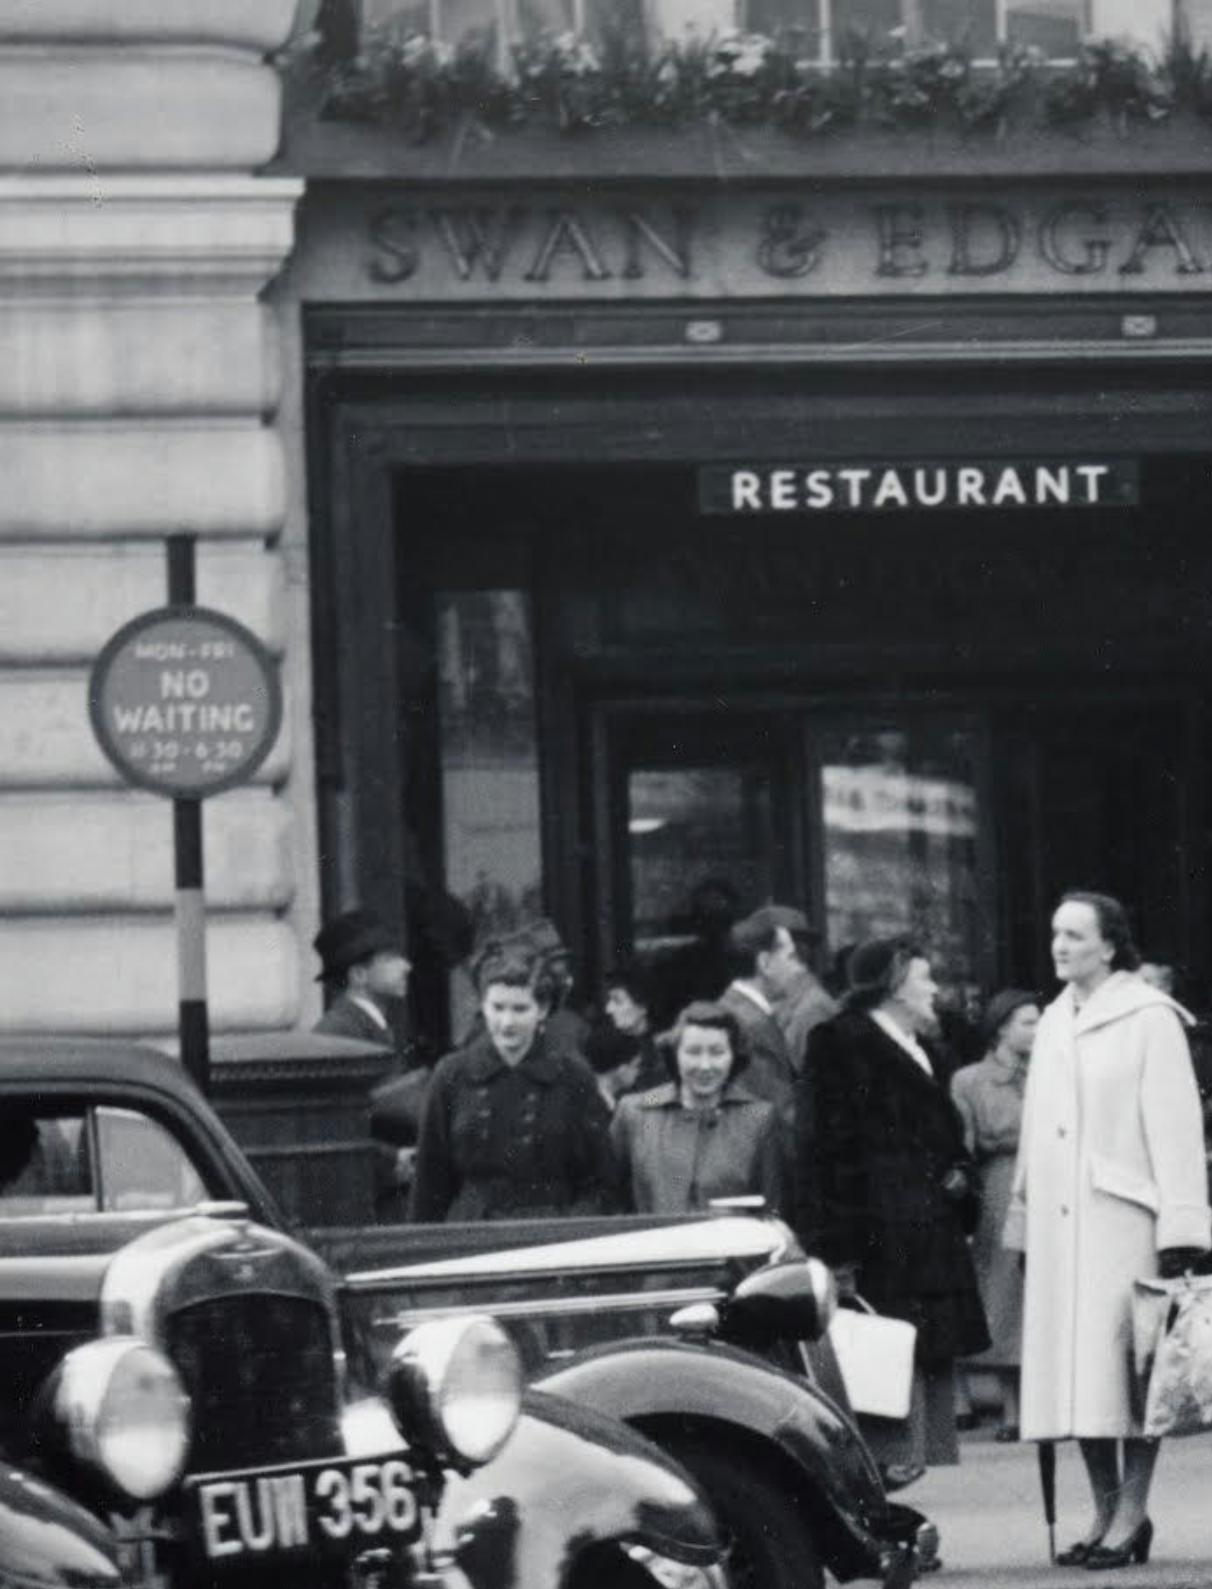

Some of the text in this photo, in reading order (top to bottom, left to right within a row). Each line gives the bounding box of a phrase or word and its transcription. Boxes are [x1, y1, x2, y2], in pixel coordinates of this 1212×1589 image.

[366, 203, 703, 284] SWAN
[755, 202, 828, 279] &
[730, 464, 1111, 510] RESTAURANT
[160, 669, 210, 699] NO
[112, 704, 255, 733] WAITING
[315, 1460, 417, 1539] 356
